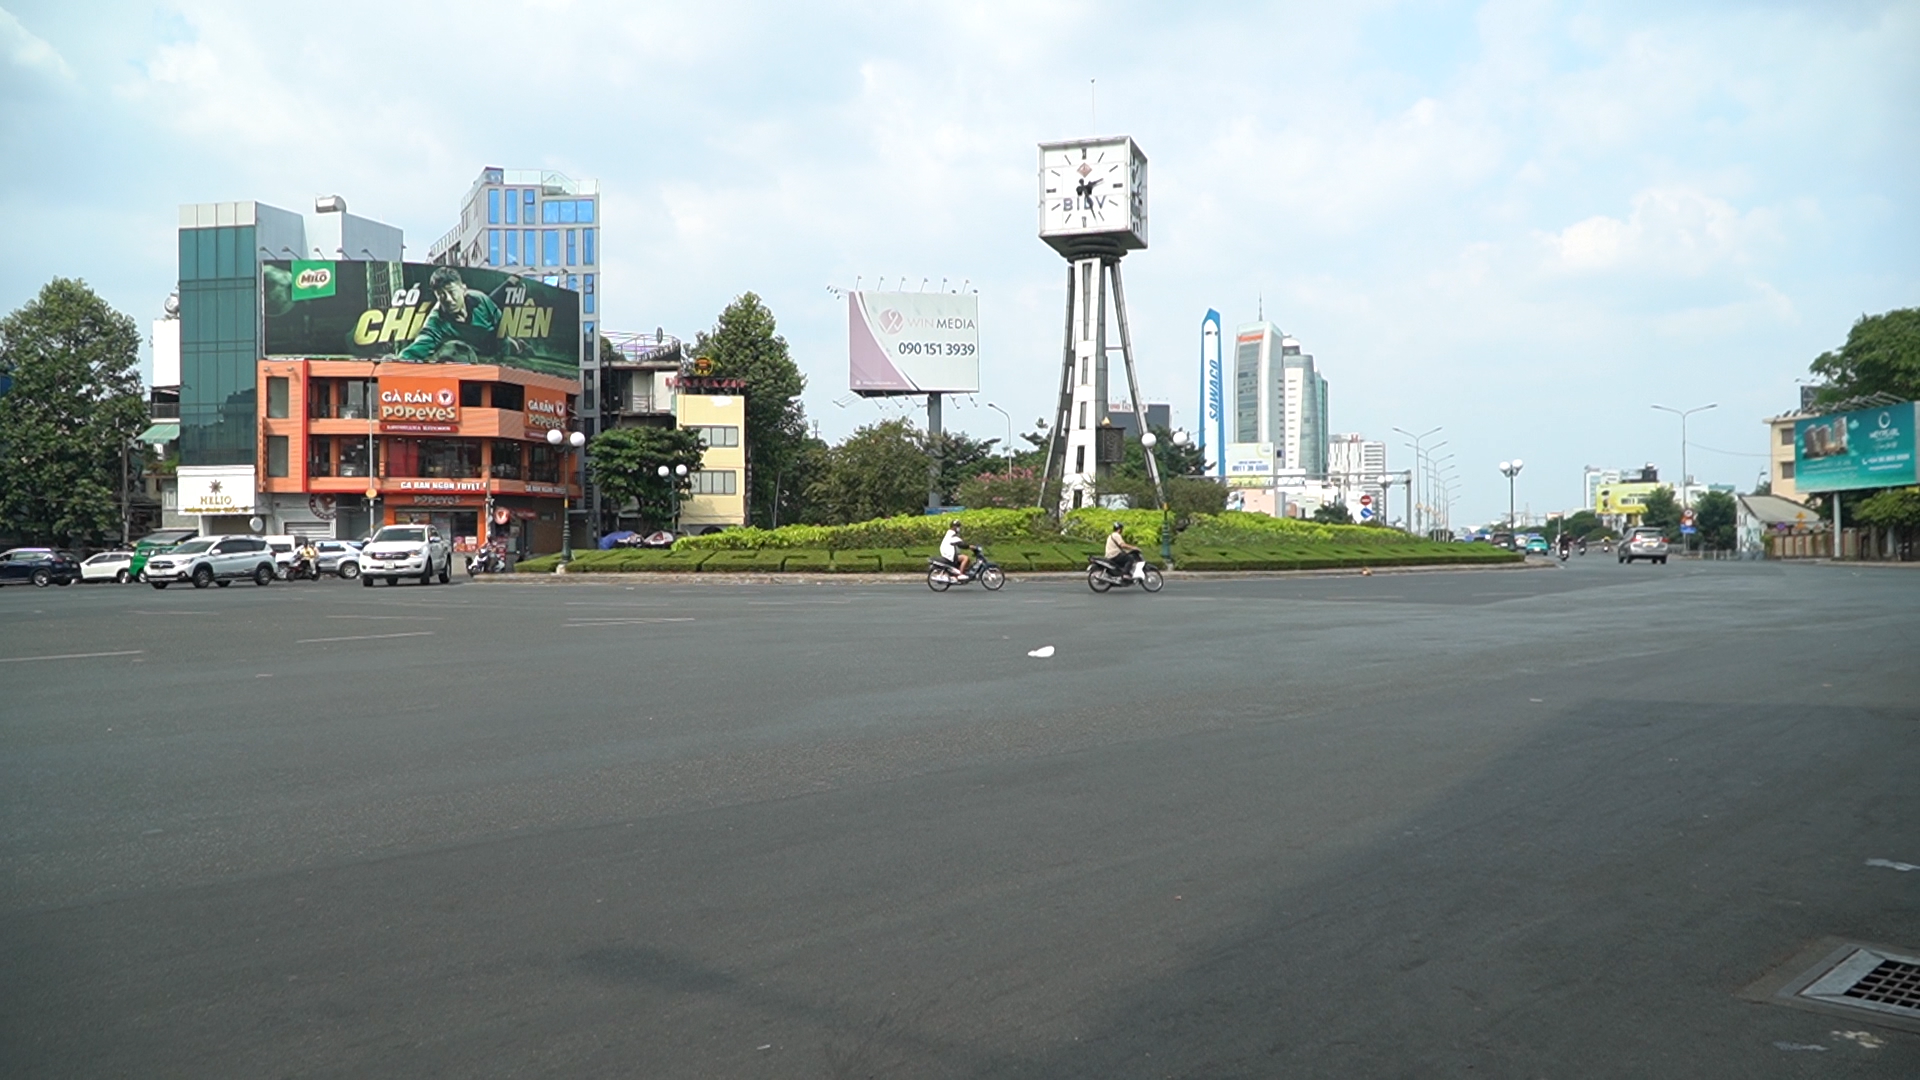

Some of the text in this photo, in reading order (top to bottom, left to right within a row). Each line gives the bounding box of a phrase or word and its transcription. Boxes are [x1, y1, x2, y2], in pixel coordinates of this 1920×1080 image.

[300, 273, 328, 284] MILO
[391, 282, 526, 307] CÓ THÌ
[354, 298, 554, 346] CHÍ NÊN
[907, 317, 976, 330] WIN MEDIA
[898, 342, 975, 356] 090 151 3939
[381, 388, 433, 403] GÀ RÁN
[1208, 358, 1219, 423] SAWACO
[200, 495, 232, 505] HELIO
